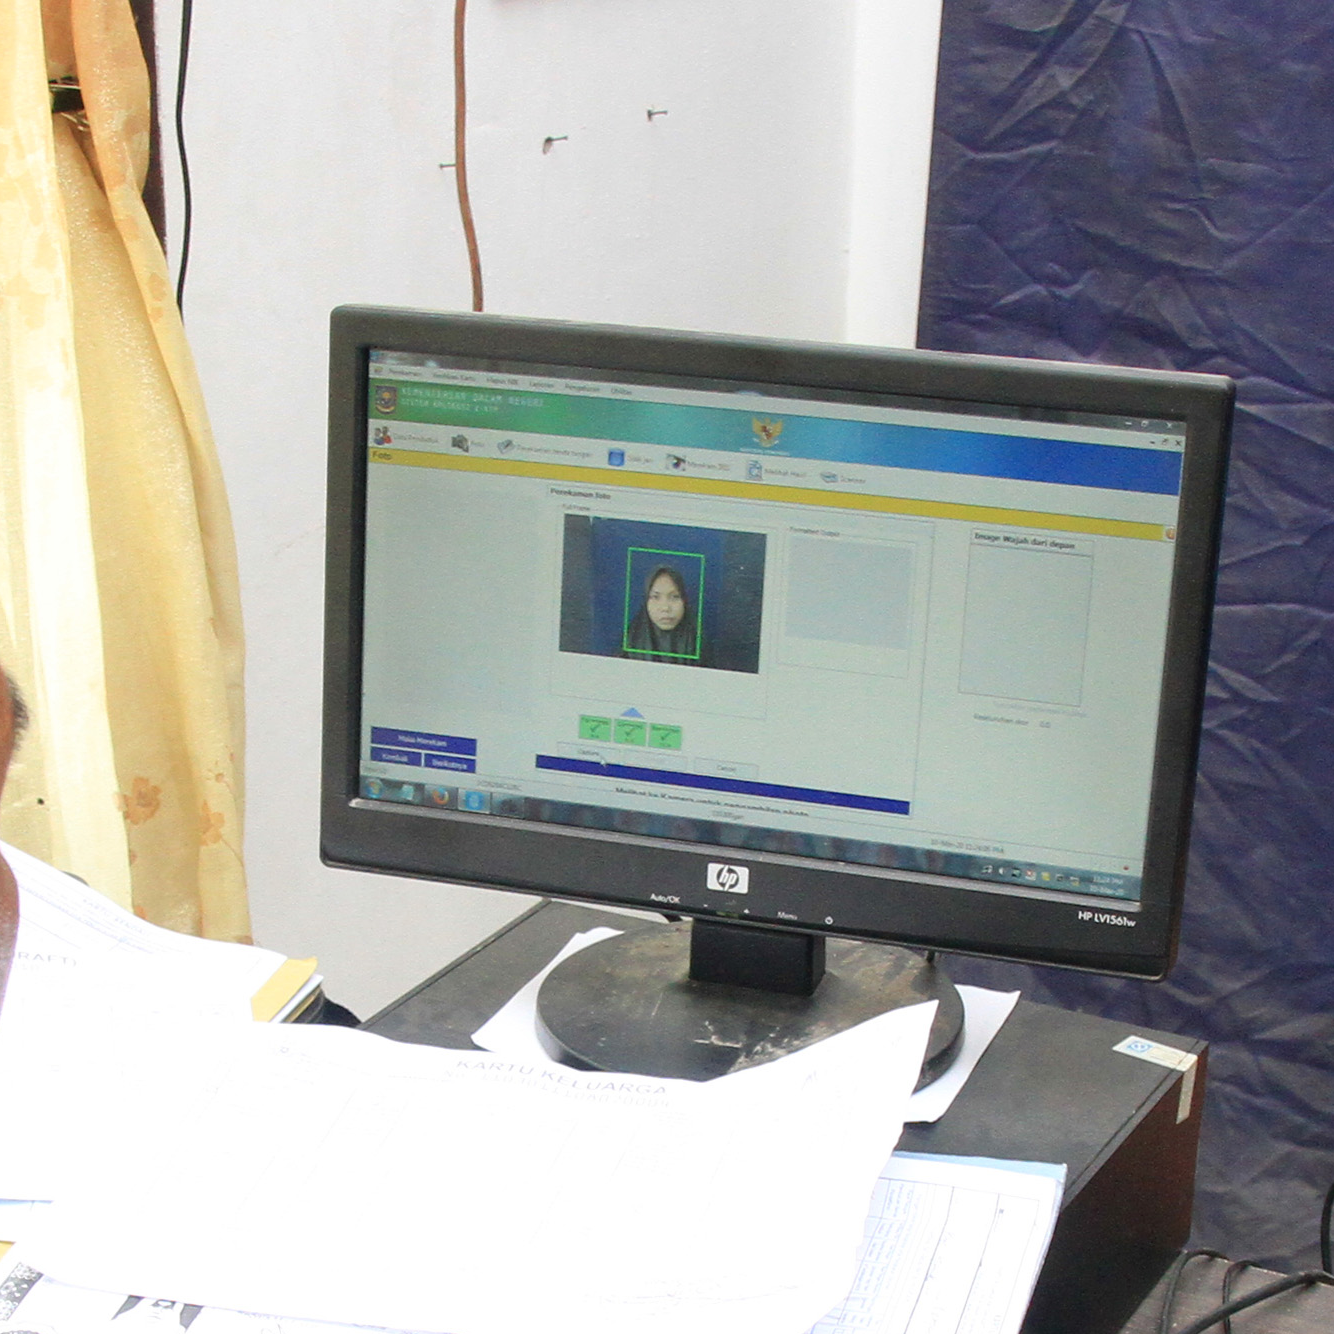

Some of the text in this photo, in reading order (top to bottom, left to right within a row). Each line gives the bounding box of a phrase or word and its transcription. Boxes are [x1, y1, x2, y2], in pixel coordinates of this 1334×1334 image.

[974, 532, 1001, 543] Image
[1003, 534, 1029, 546] Wajah
[650, 893, 681, 904] Auto/OK
[777, 911, 798, 920] Menu
[1078, 910, 1137, 928] HP LV1561w
[17, 951, 77, 967] RAFT)
[456, 1060, 534, 1075] KARTU
[541, 1070, 667, 1095] KELUARGA
